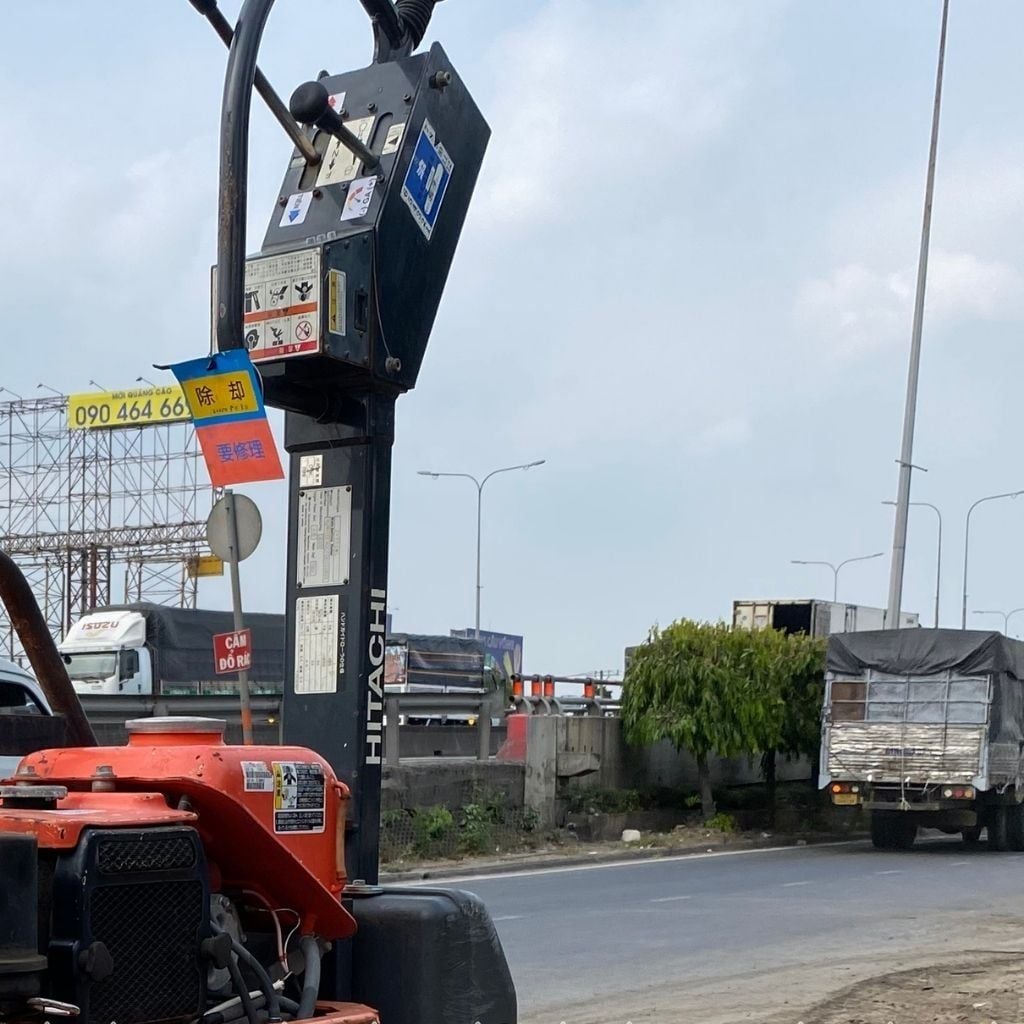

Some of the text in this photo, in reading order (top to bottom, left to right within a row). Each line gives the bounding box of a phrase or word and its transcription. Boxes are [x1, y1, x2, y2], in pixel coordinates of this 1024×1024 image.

[76, 404, 110, 426] 090
[117, 399, 152, 421] 464
[160, 396, 192, 418] 66
[82, 621, 119, 631] ISUZU
[366, 588, 386, 765] HITACHI
